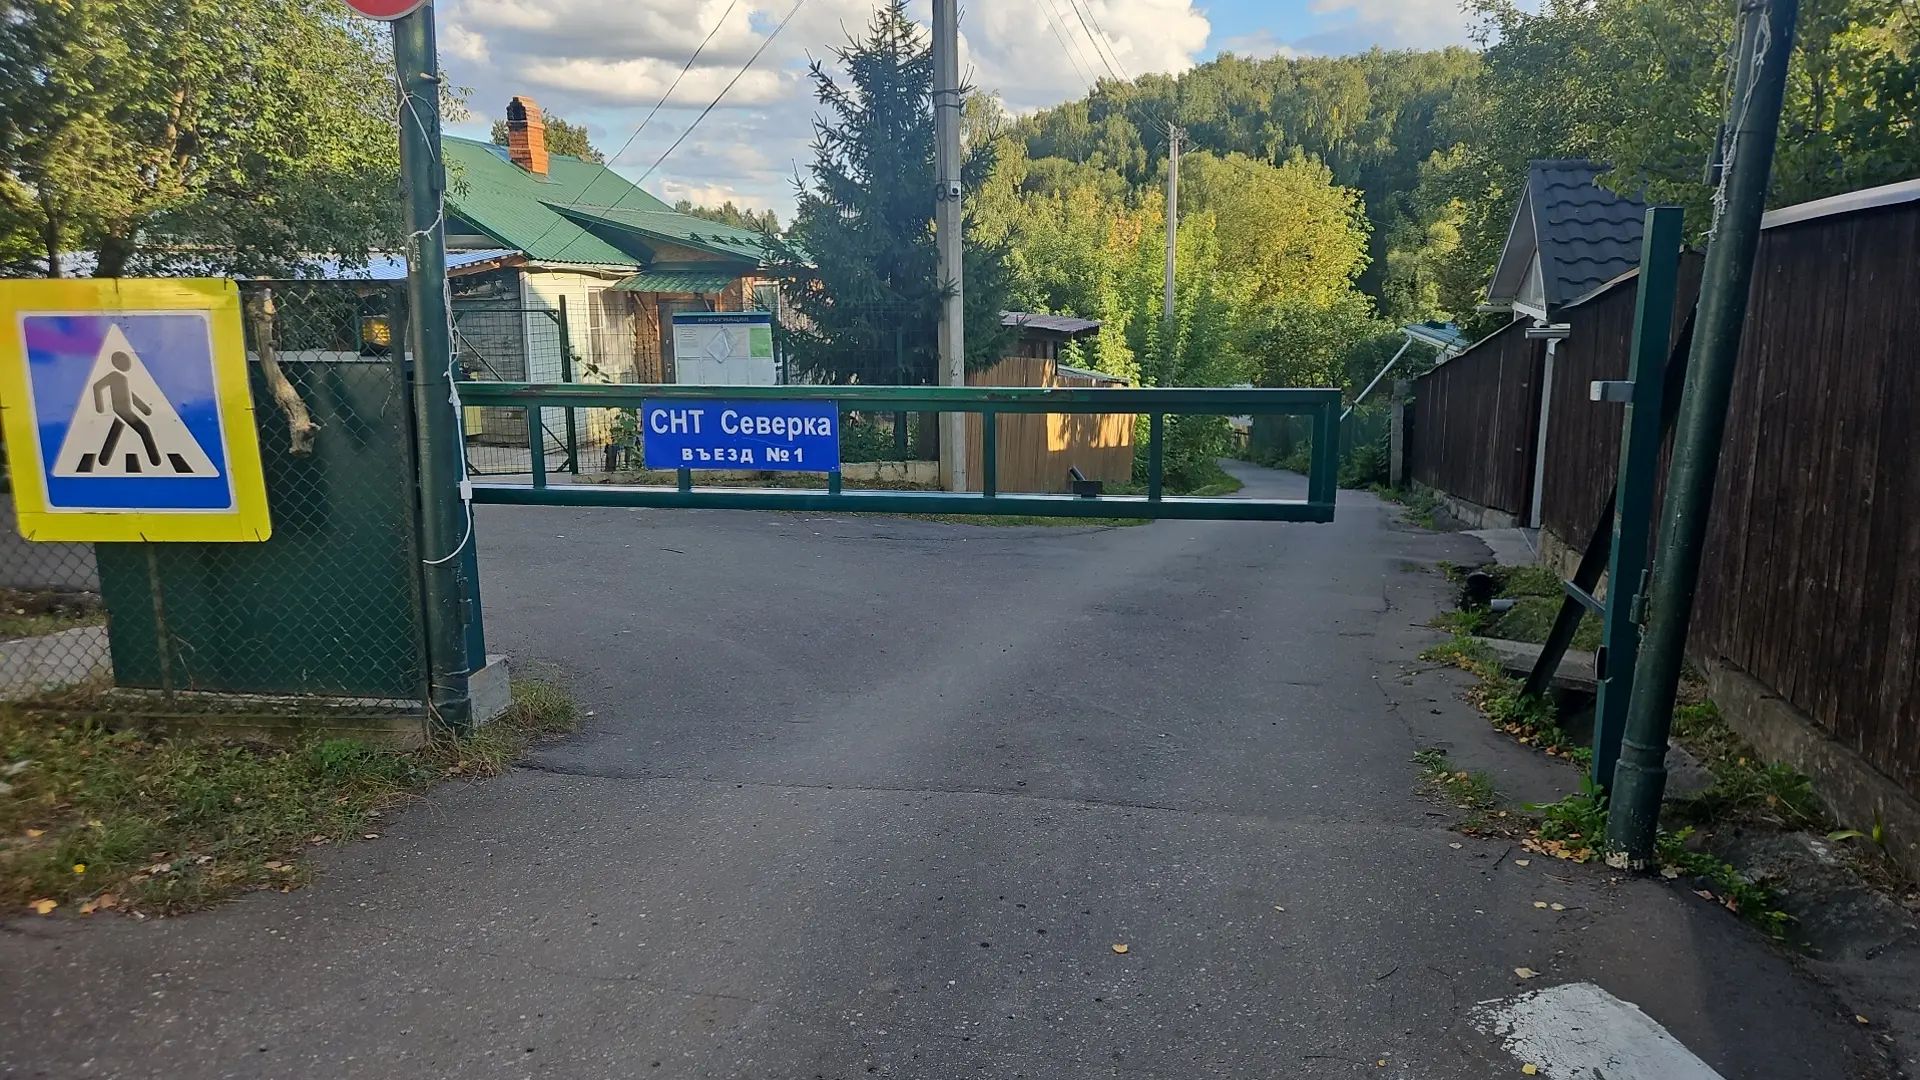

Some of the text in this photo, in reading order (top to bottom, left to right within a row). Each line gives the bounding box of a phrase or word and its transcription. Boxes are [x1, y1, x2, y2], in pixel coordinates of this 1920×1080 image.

[650, 409, 832, 442] СНТ Северка
[682, 448, 754, 464] ВЪЕЗД
